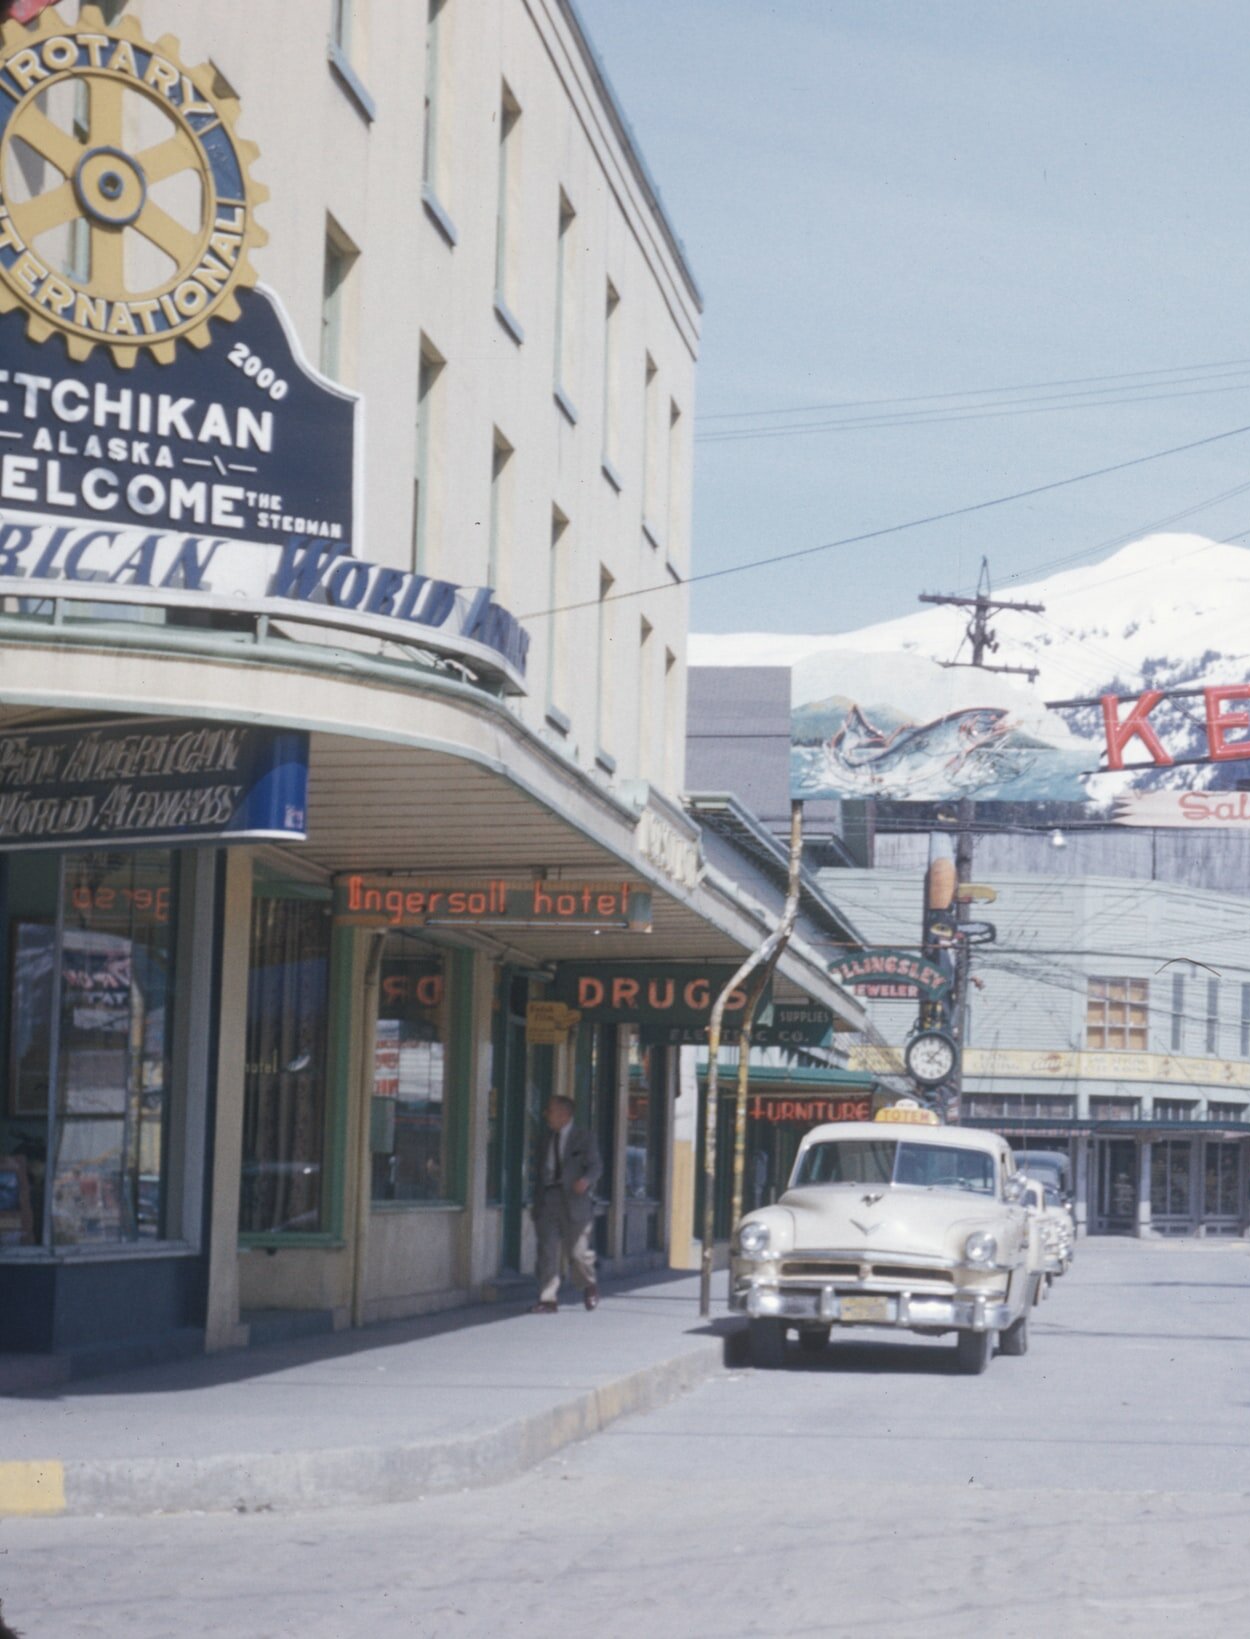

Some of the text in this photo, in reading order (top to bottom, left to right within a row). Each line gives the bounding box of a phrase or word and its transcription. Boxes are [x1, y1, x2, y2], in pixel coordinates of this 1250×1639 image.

[6, 33, 217, 118] ROTARY
[0, 204, 246, 336] TERNATIONAL
[227, 342, 289, 400] 2000
[32, 426, 175, 469] ALASKA
[1, 453, 245, 529] ELCOME
[246, 490, 282, 511] THE
[257, 512, 342, 539] STEDMAN
[60, 727, 248, 780] AMERICAN
[92, 784, 243, 831] AIRWAYS
[348, 876, 630, 924] Ingersoll hotel
[578, 977, 749, 1010] DRUGS
[853, 983, 919, 997] EWELER
[778, 1010, 830, 1024] SUPPLIES
[751, 1097, 871, 1122] FURNITURE
